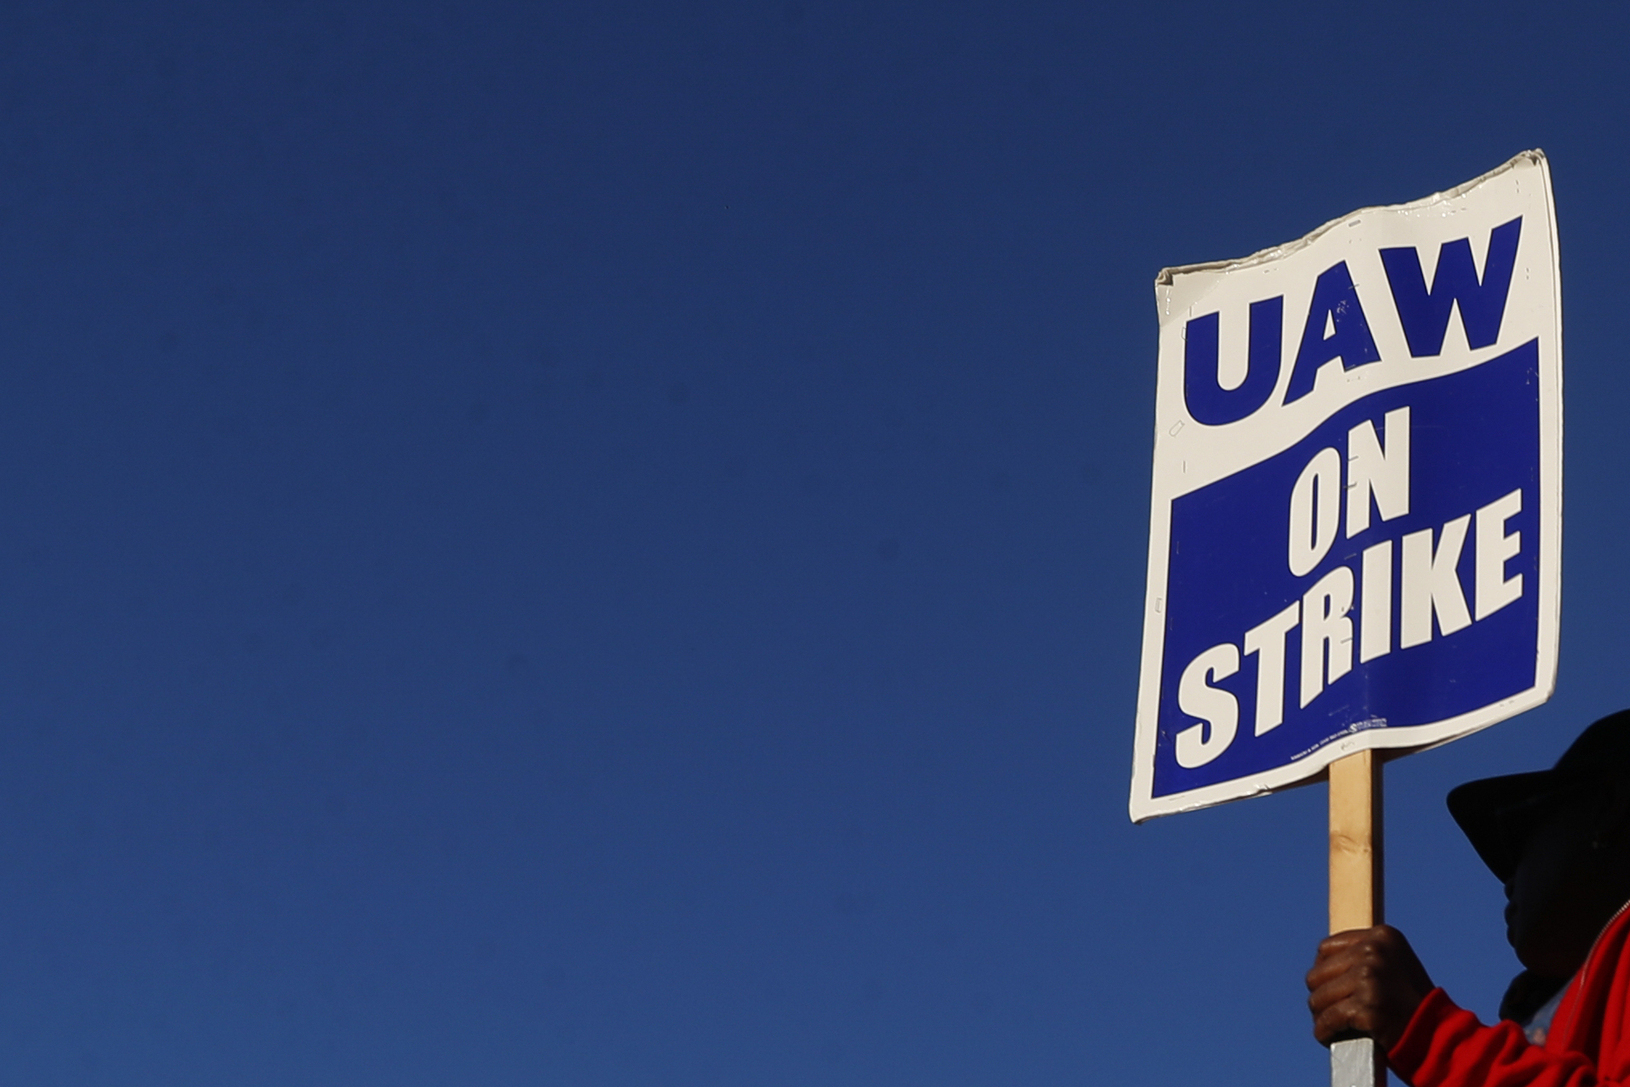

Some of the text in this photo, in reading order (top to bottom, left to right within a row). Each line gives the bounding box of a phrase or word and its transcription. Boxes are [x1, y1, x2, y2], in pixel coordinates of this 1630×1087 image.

[1184, 215, 1523, 426] UAW
[1288, 405, 1411, 577] ON
[1175, 488, 1523, 769] STRIKE
